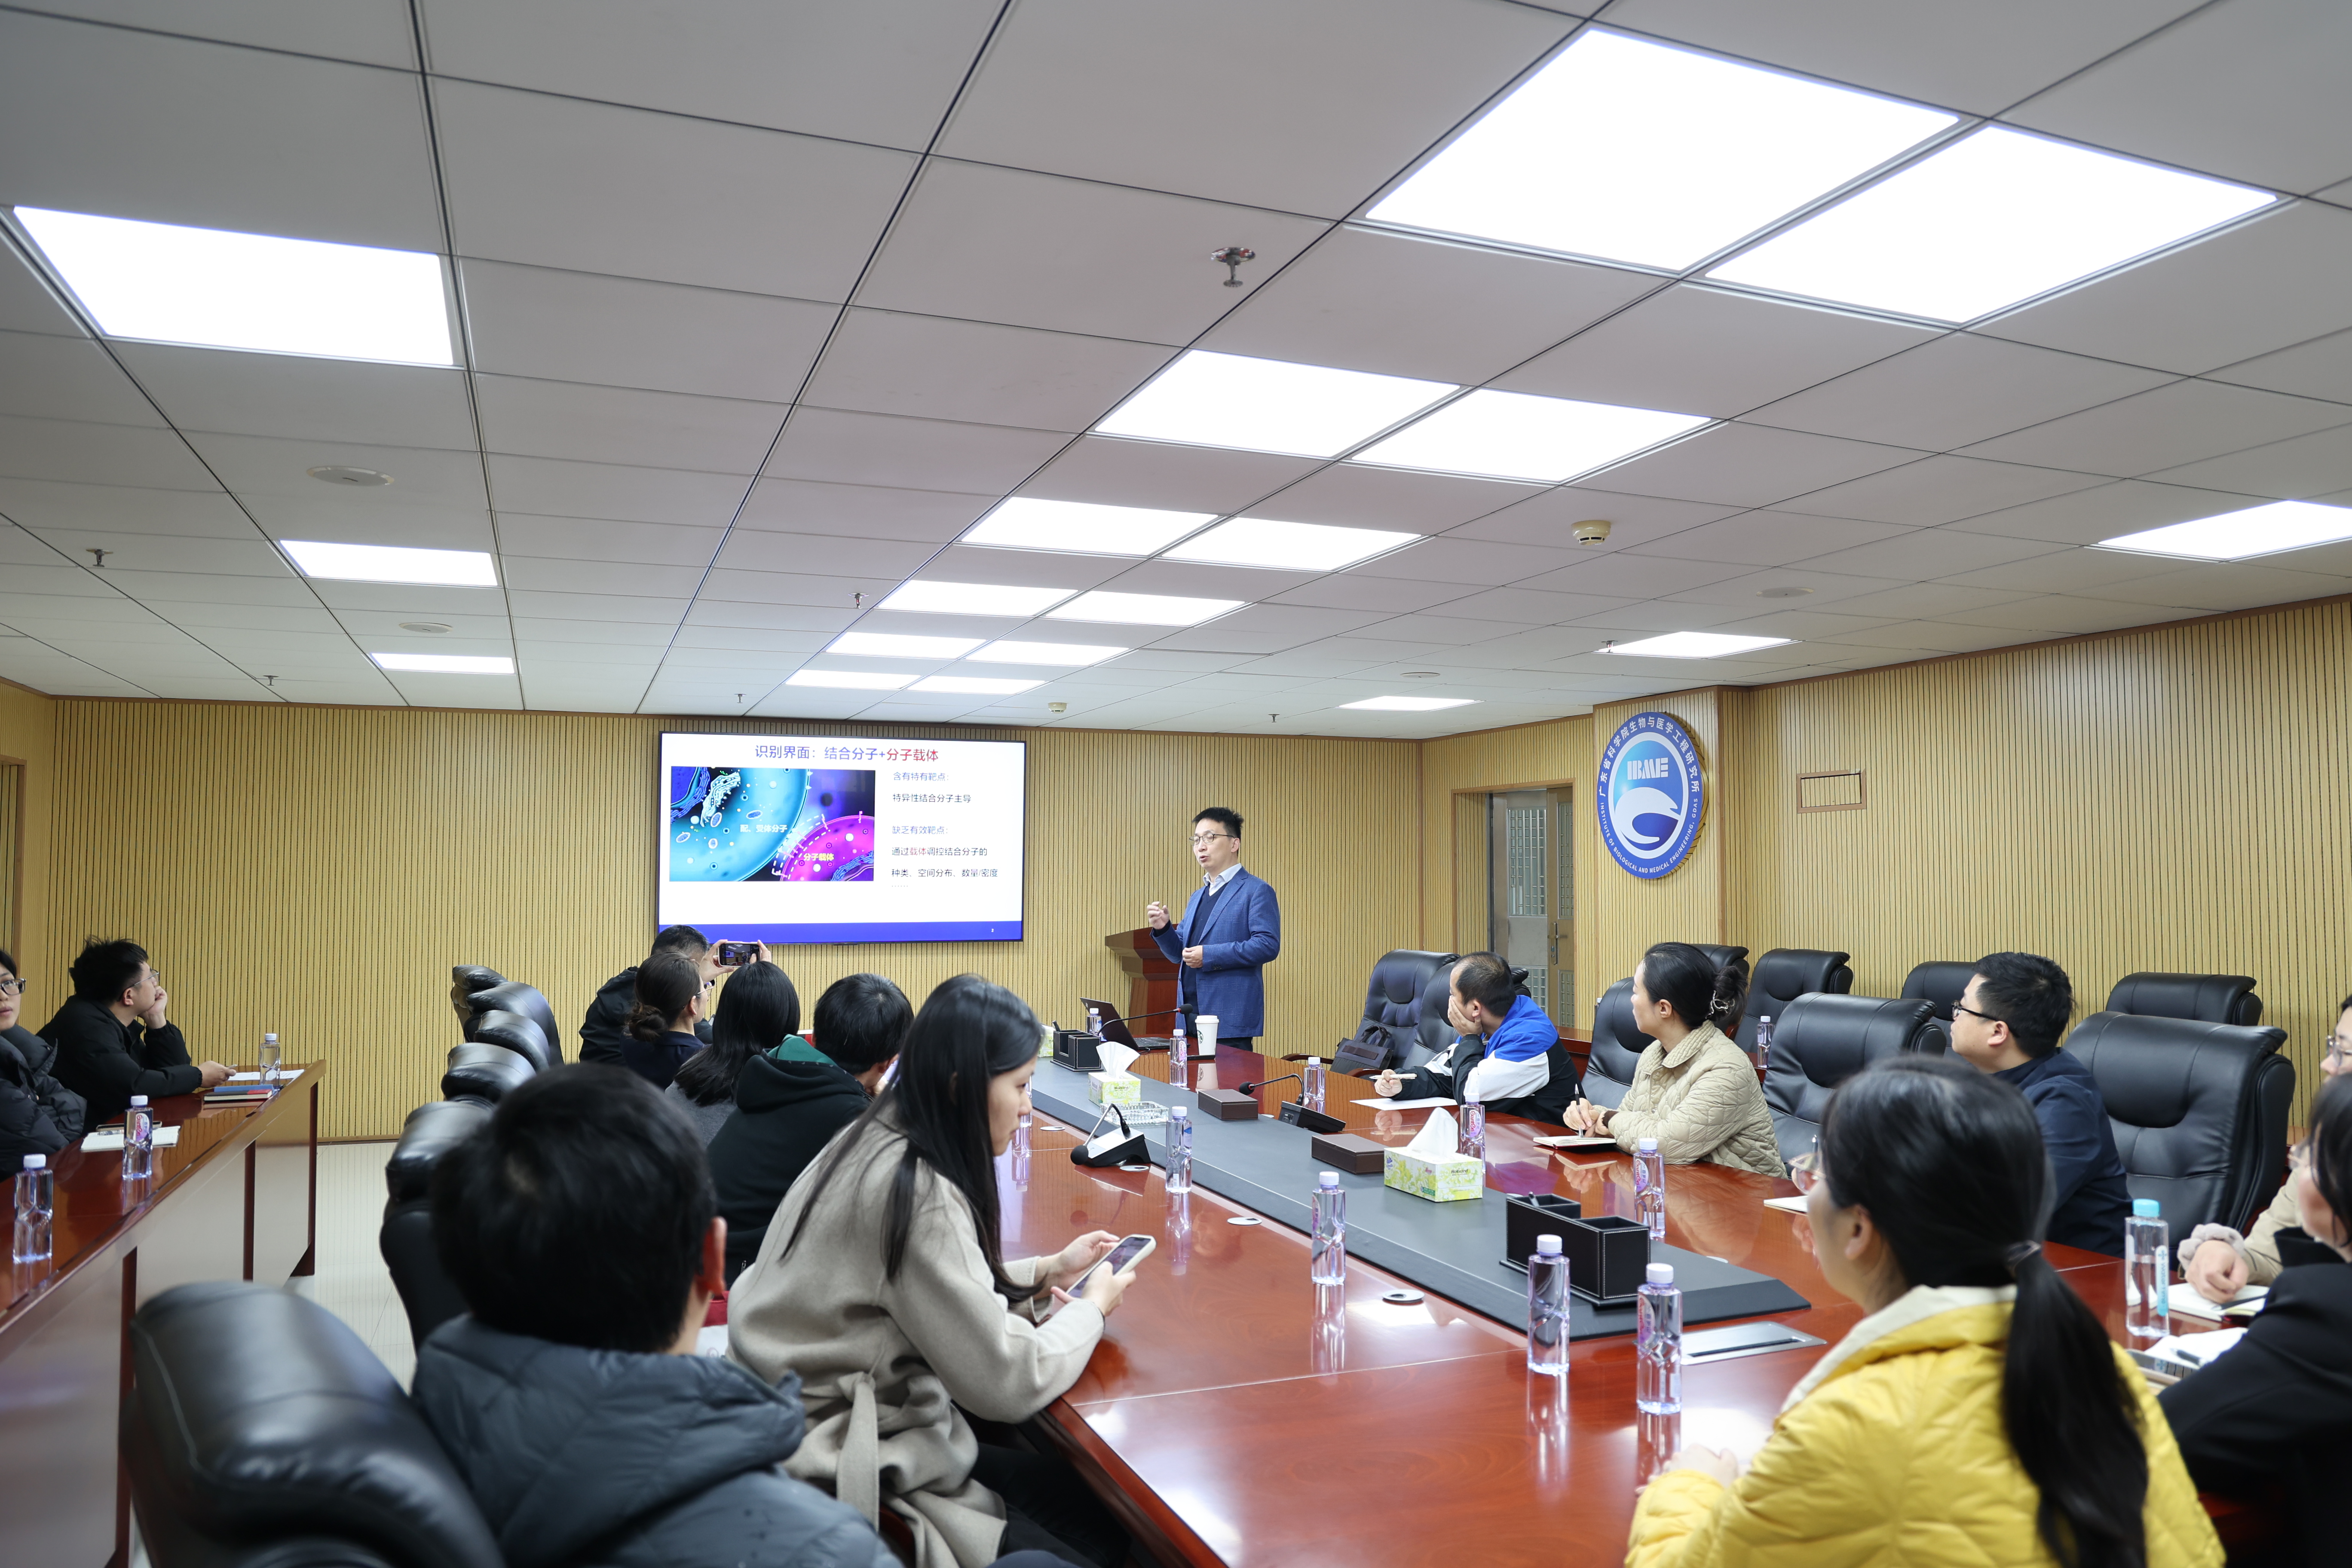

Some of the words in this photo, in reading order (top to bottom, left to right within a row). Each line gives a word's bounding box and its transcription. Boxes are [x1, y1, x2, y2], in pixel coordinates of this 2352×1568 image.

[755, 745, 939, 762] 识别界面：结合分子+分子载体
[1599, 716, 1700, 797] 广东省科学院生物与医学工程研究所
[1627, 757, 1668, 780] IBME
[892, 793, 971, 803] 特异性结合分子主导
[740, 824, 787, 833] 配、受体分子
[1600, 802, 1611, 838] INSTITUTE
[1609, 838, 1614, 846] OF
[1613, 847, 1637, 871] BIOLOGICAL
[1650, 861, 1670, 873] MEDICAL
[1669, 822, 1695, 864] ENGINEERING,
[891, 847, 987, 856] 通过载体调控结合分子的
[803, 853, 834, 861] 分子载体
[891, 868, 998, 877] 种类、空间分布、数量/密度
